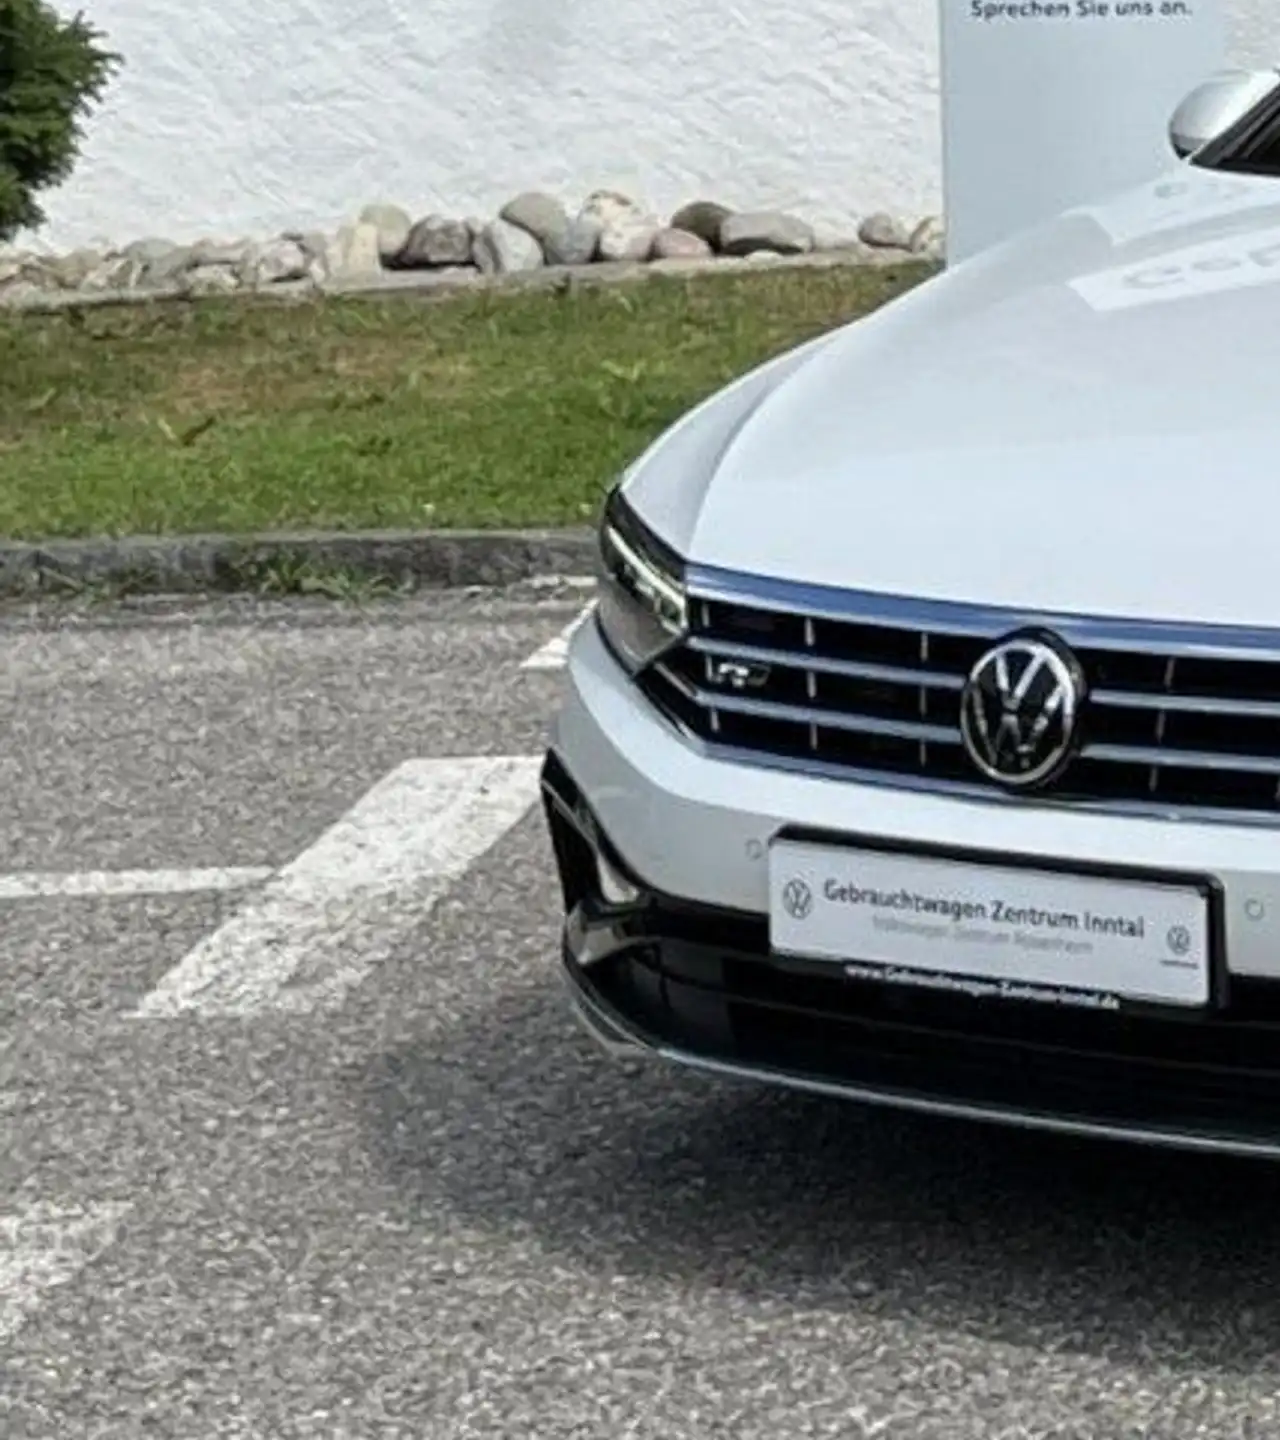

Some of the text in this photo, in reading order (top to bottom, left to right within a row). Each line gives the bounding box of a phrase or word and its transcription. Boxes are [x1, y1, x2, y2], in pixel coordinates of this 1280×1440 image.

[1115, 1, 1154, 17] uns
[1159, 1, 1193, 17] an.
[822, 877, 987, 922] Gebrauchtwagen
[990, 899, 1080, 930] Zentrum
[1083, 909, 1146, 939] Inntal
